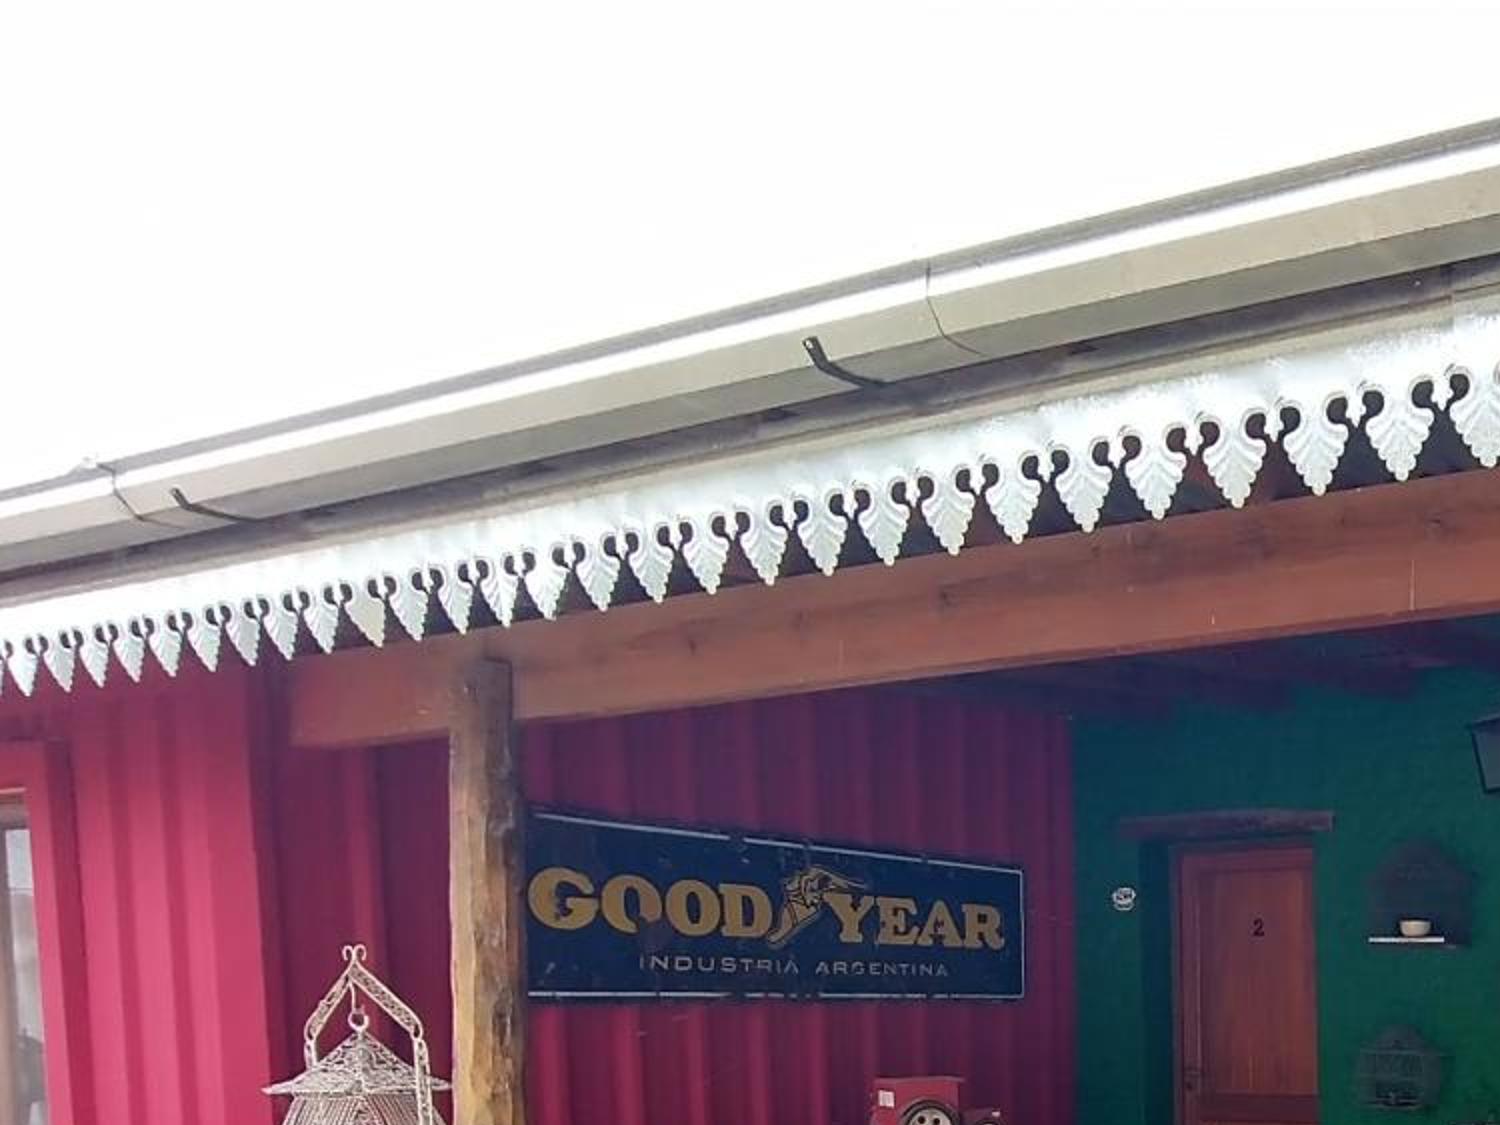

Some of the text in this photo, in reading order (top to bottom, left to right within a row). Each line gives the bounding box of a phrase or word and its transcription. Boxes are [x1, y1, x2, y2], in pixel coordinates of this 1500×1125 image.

[527, 867, 1005, 950] GOOD YEAR
[1252, 918, 1265, 937] 2
[639, 955, 949, 977] INDUSTRIA ARGENTINA
